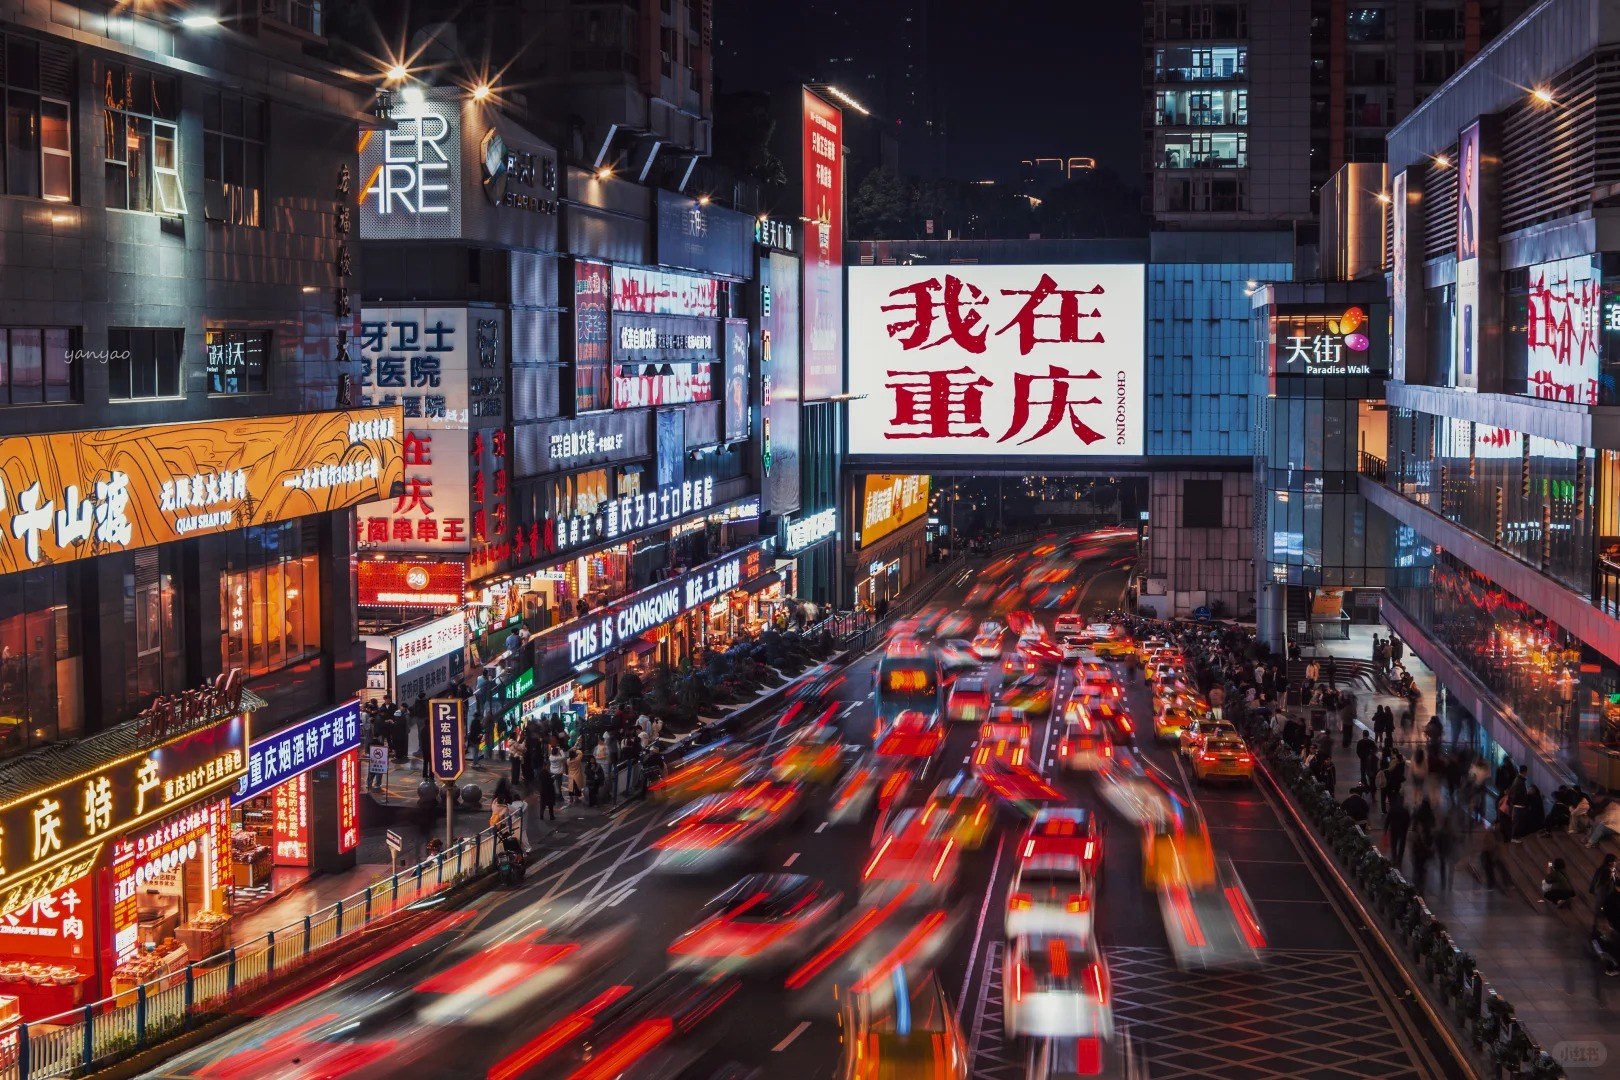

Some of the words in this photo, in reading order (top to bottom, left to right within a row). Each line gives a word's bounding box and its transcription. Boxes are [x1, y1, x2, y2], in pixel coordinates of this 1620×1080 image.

[880, 273, 1105, 355] 我在
[1285, 334, 1342, 365] 天街
[1306, 365, 1347, 376] Paradise
[1348, 364, 1371, 376] Walk
[883, 364, 1106, 446] 重庆
[1116, 370, 1126, 445] CHONGQING
[557, 514, 591, 549] 串串王
[606, 475, 714, 538] 重庆牙卫士口腔医院
[568, 623, 597, 664] THIS
[602, 616, 612, 648] IS
[617, 587, 679, 640] CHONGQING
[439, 704, 451, 720] P
[249, 711, 357, 788] 重庆烟酒特产超市
[440, 722, 453, 771] 宏福俊悦
[164, 749, 242, 803] 重庆36个区县特色
[0, 758, 161, 875] 庆特产
[60, 887, 84, 940] 牛肉
